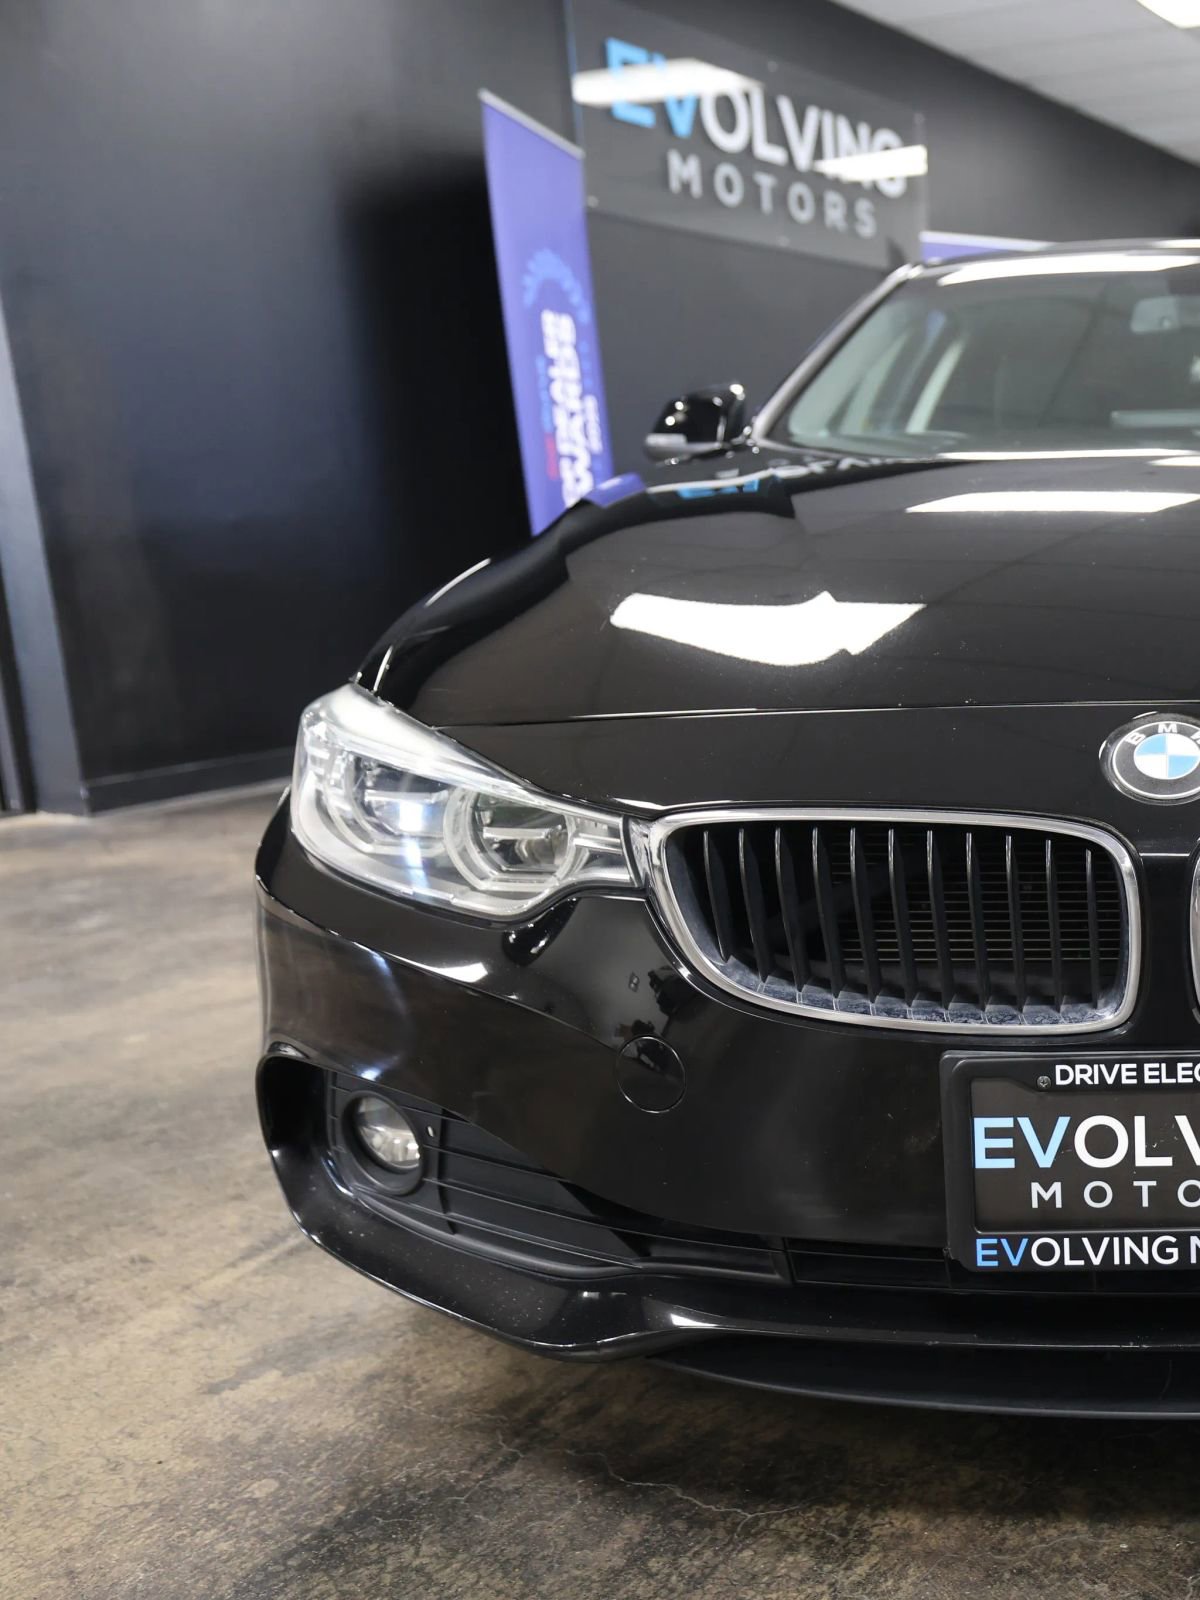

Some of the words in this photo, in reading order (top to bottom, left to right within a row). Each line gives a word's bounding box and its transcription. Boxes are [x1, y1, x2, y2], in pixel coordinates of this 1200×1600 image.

[667, 149, 877, 239] MOTORS
[1055, 1063, 1138, 1086] DRIVE
[976, 1235, 1180, 1267] EVOLVING
